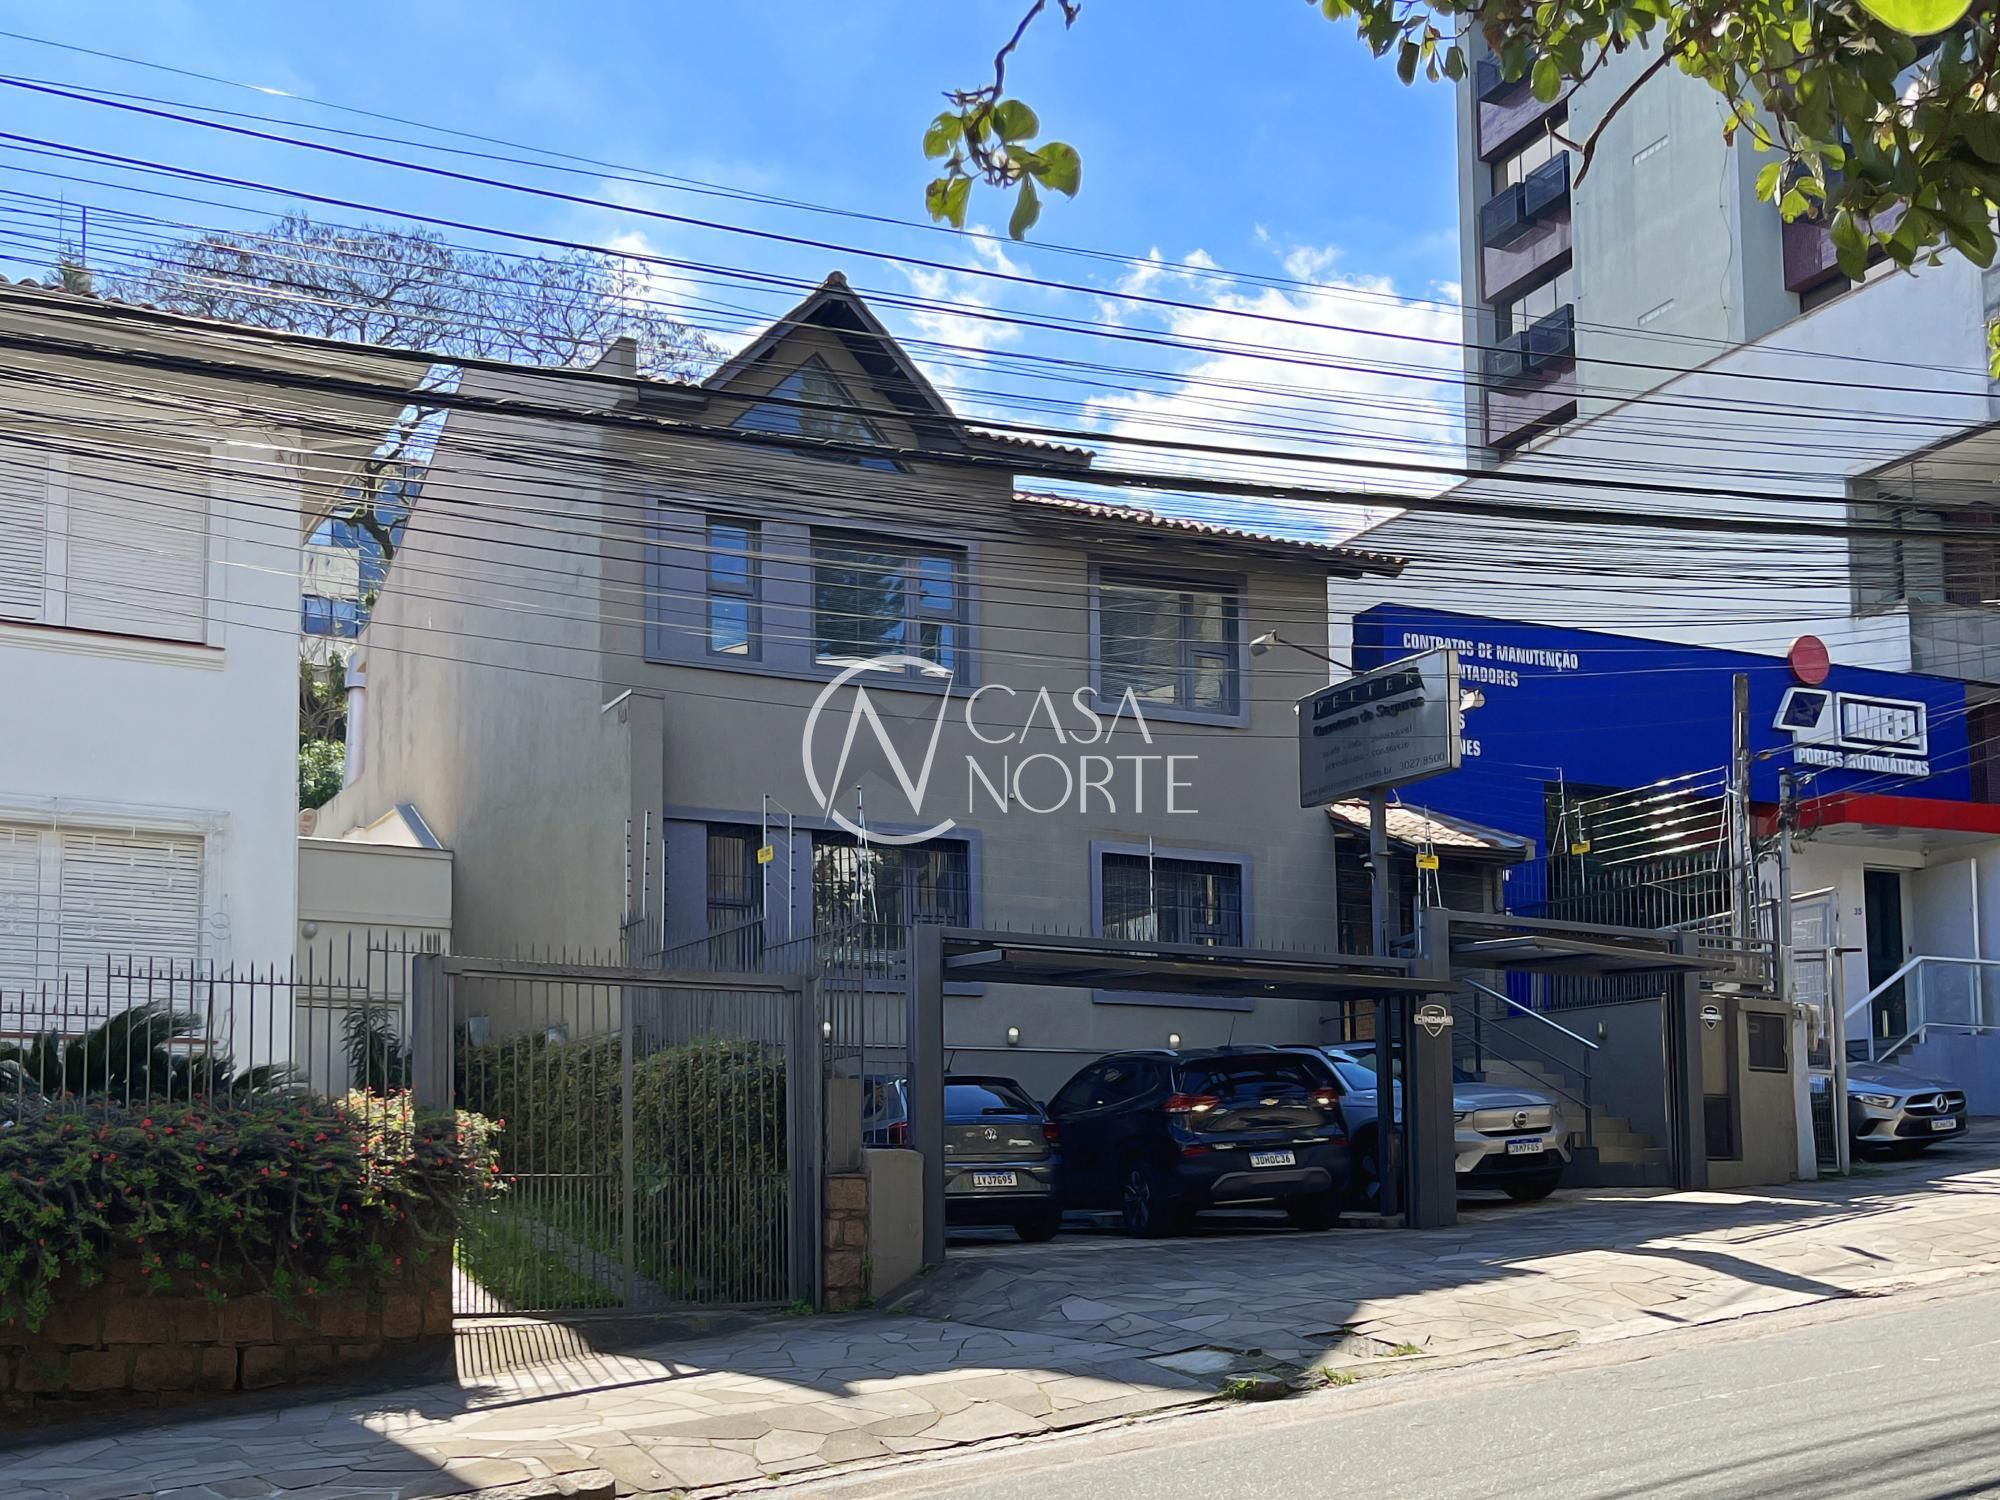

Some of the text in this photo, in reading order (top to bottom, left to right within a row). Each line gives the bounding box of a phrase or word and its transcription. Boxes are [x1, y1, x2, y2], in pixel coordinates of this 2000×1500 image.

[1403, 633, 1578, 672] CONTRATOS DE MANUTENÇÃO
[1457, 664, 1519, 687] NTADORES
[1796, 748, 1930, 776] PORTAS AUTOMÁTICAS
